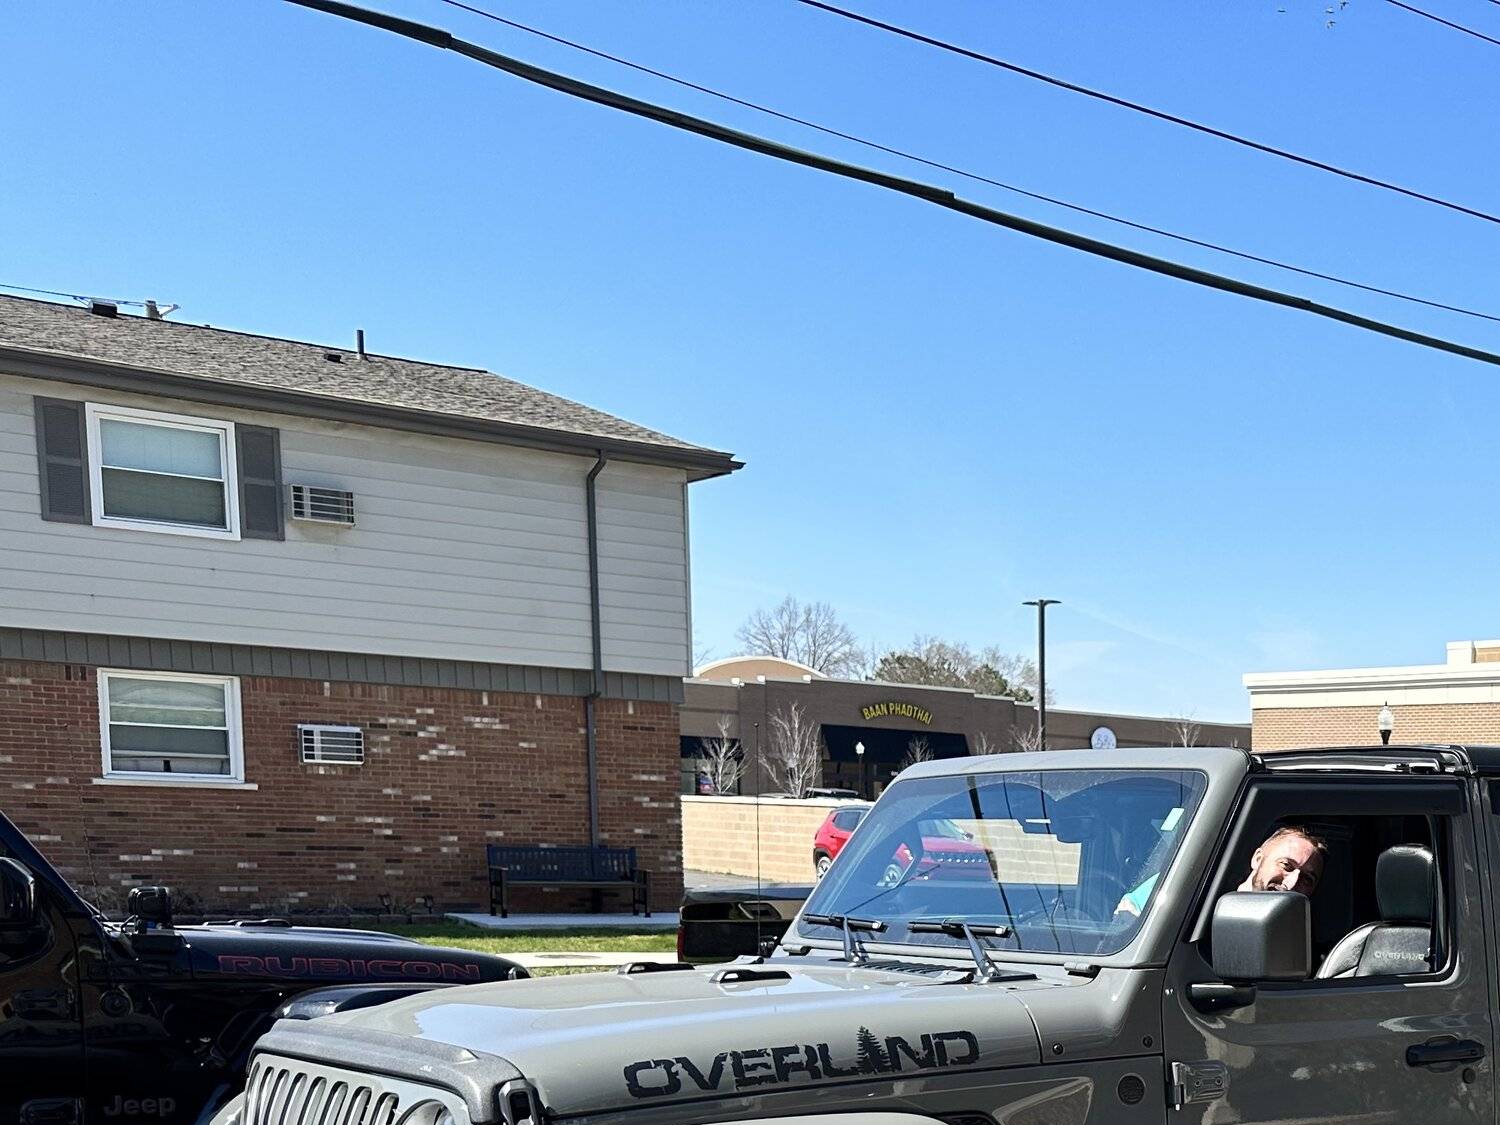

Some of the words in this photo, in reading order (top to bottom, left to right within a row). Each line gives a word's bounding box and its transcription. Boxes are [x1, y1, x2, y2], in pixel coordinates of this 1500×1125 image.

[862, 703, 887, 720] BAAN
[219, 955, 481, 980] RUBICON
[624, 1025, 980, 1099] OVERLAND
[103, 1094, 176, 1118] Jeep
